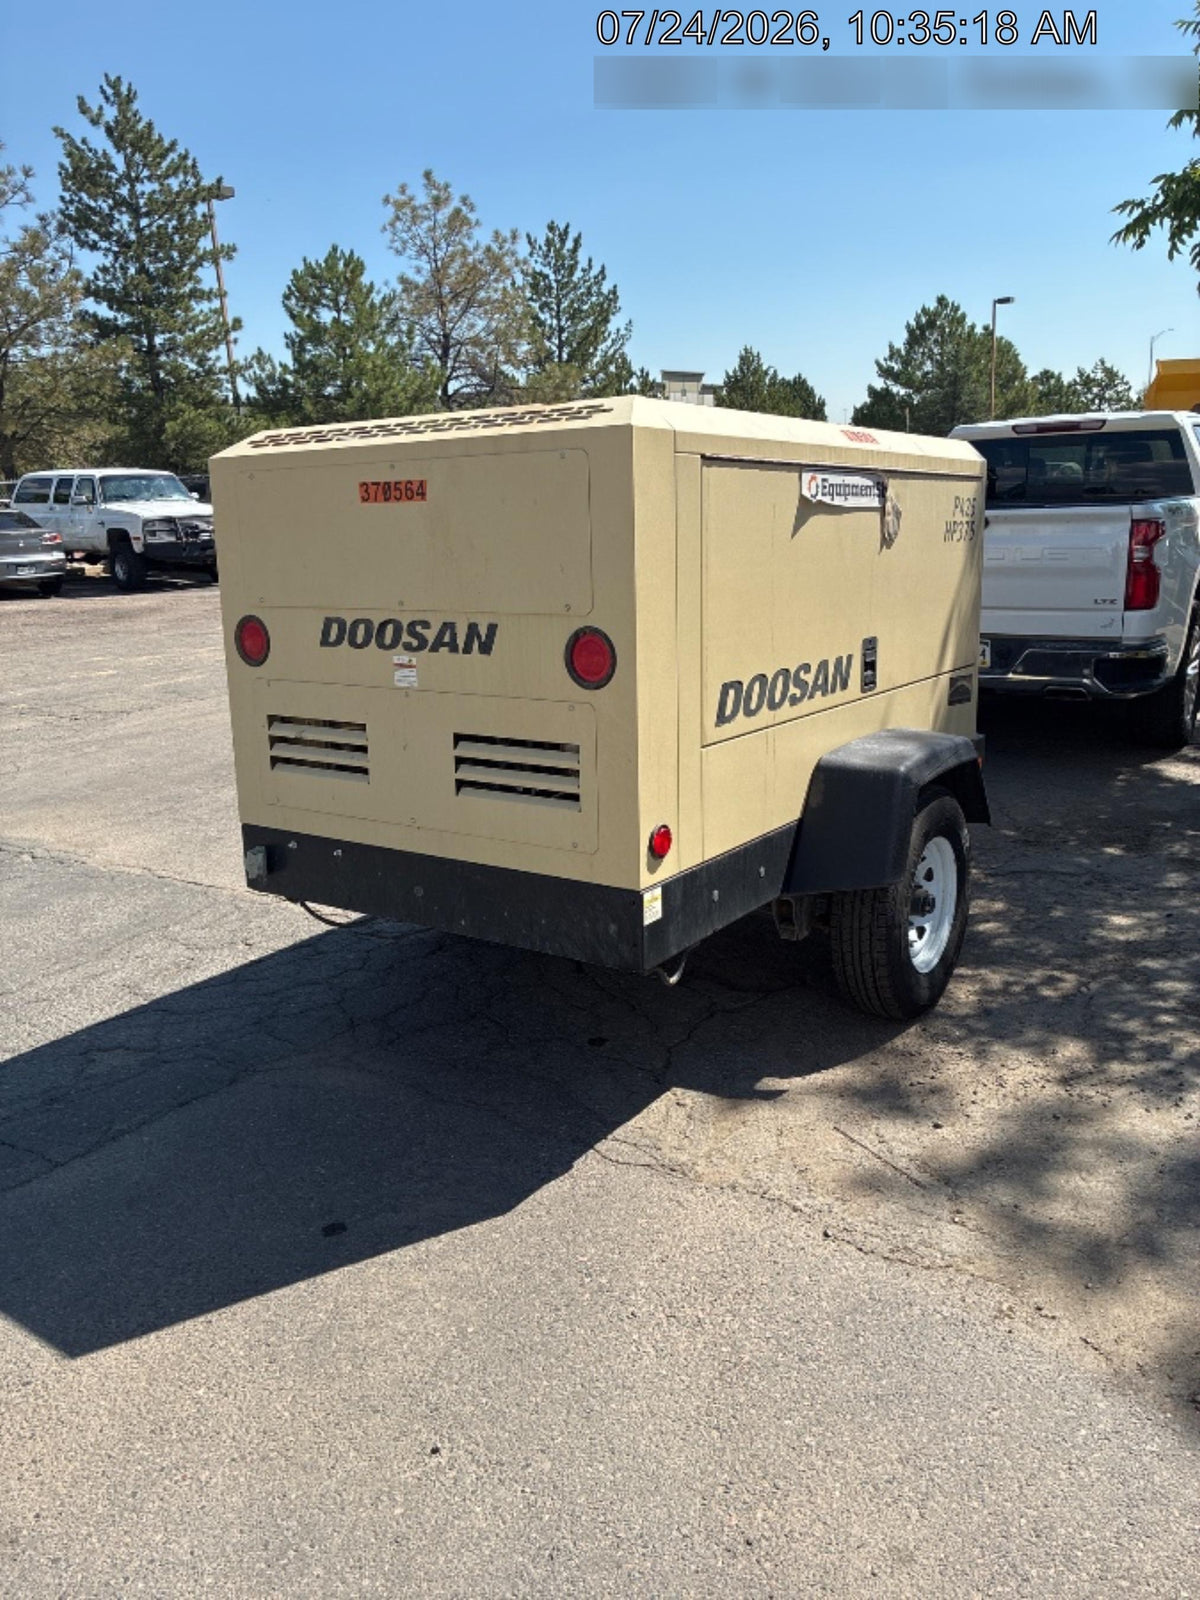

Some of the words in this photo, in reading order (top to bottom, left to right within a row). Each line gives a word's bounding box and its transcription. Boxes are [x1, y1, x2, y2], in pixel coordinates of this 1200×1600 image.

[360, 480, 426, 502] 370564
[320, 616, 498, 656] DOOSAN
[715, 653, 853, 727] DOOSAN
